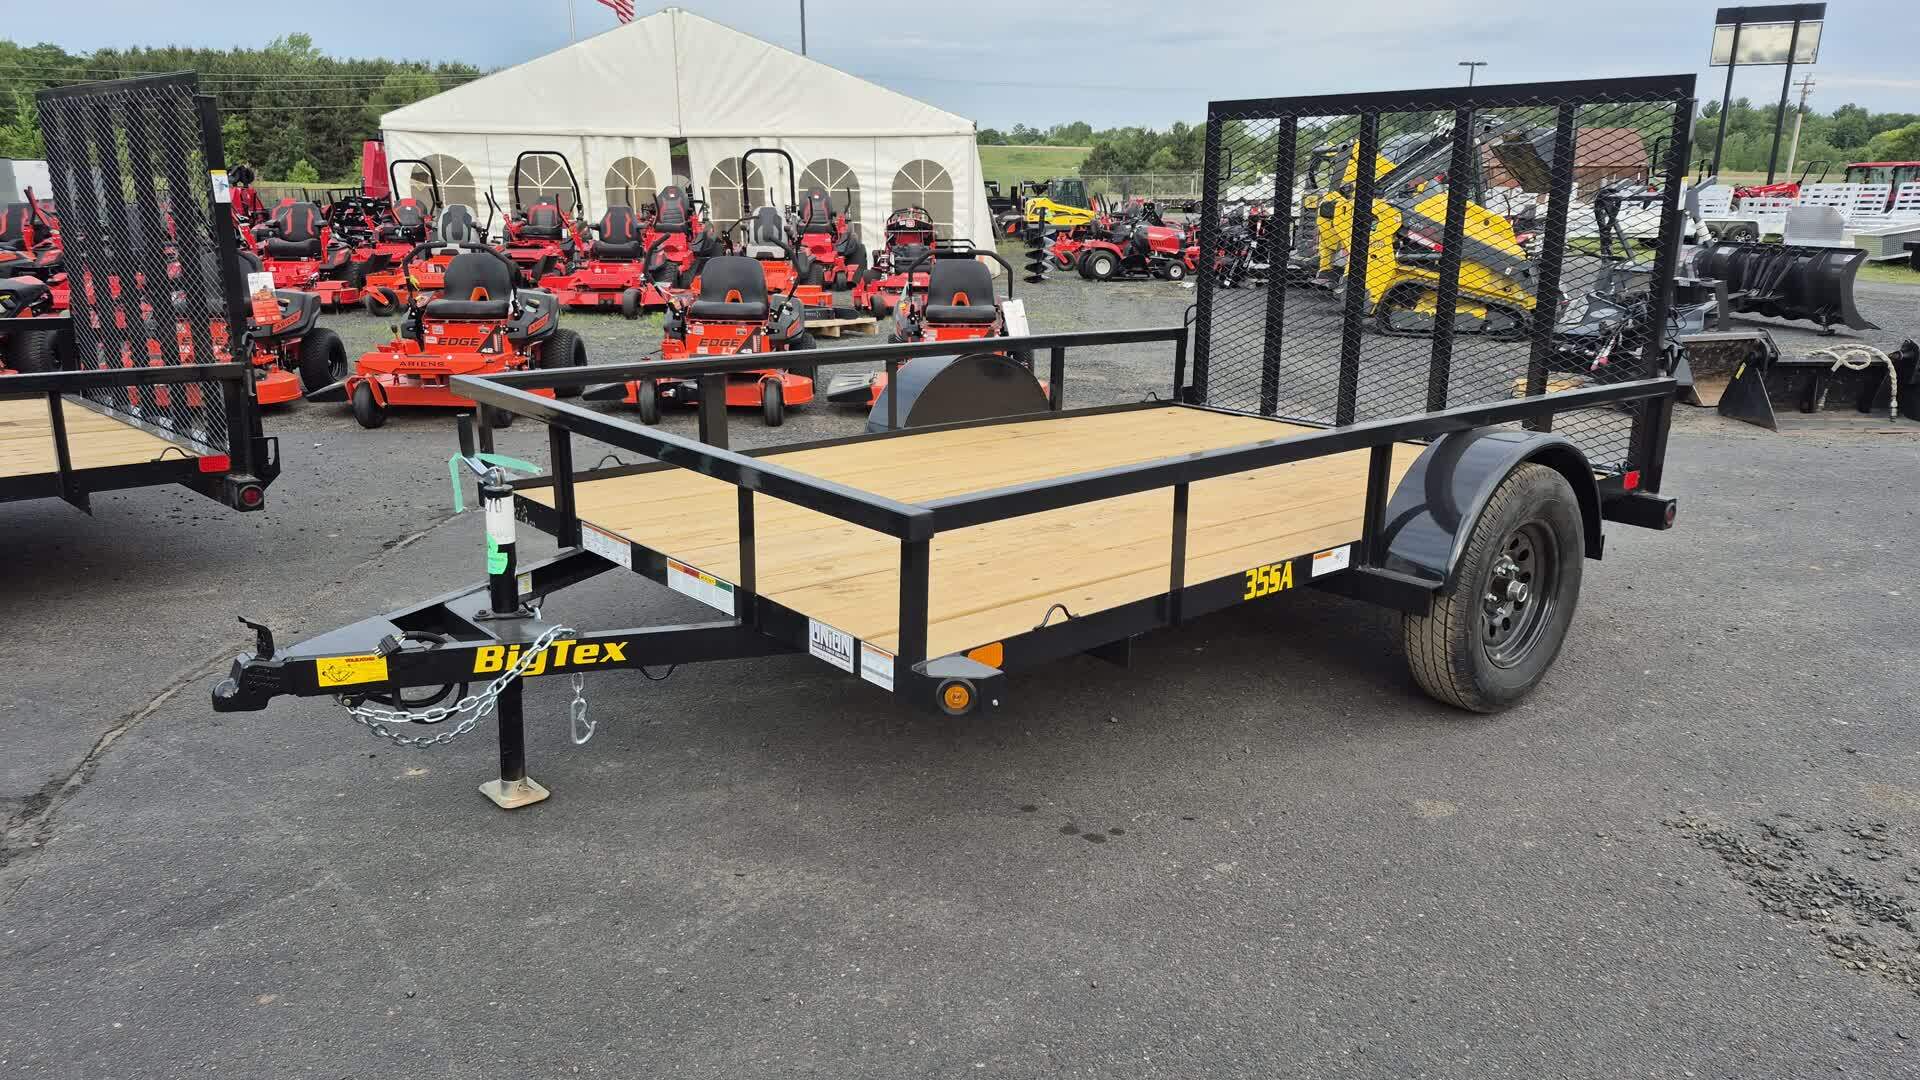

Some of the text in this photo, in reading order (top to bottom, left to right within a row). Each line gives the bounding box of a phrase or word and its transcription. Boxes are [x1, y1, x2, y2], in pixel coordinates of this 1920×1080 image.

[437, 337, 480, 346] EDGE
[699, 338, 740, 347] EDGE
[473, 639, 628, 677] BigTex
